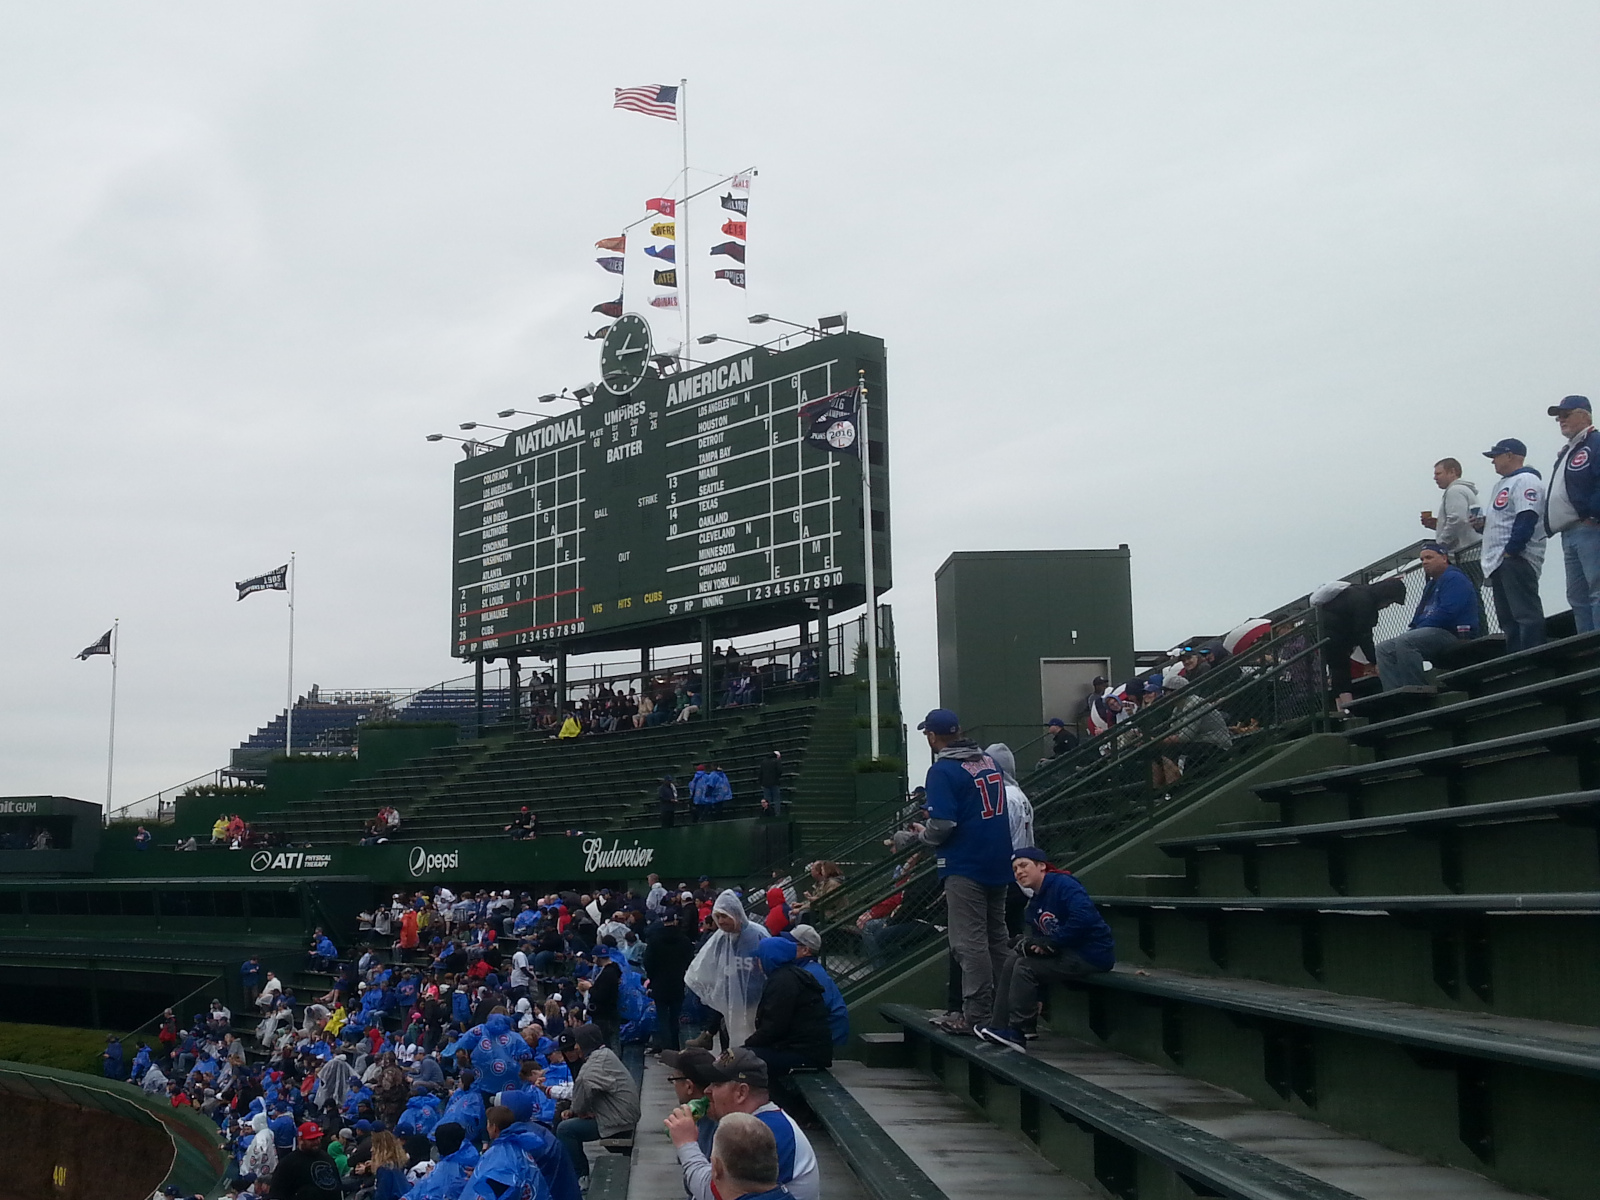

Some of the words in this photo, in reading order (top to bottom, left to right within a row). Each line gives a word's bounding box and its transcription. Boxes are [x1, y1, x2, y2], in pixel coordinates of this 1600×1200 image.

[666, 356, 753, 407] AMERICAN
[604, 401, 646, 426] UMPIRES
[698, 405, 707, 417] LOS
[708, 398, 729, 414] ANGELES
[698, 415, 727, 433] HOUSTON
[516, 415, 585, 457] NATIONAL
[590, 428, 603, 439] PLATE
[612, 431, 618, 442] 32
[631, 425, 637, 437] 37
[698, 432, 724, 449] DETROIT
[829, 430, 853, 439] 2016
[607, 440, 642, 463] BATTER
[698, 450, 718, 465] TAMPA
[720, 446, 732, 458] BAY
[483, 469, 508, 485] COLORADO
[698, 466, 718, 480] MIAMI
[669, 477, 677, 489] 13
[699, 480, 724, 496] SEATTLE
[483, 498, 504, 512] ARIZONA
[638, 494, 658, 508] STRIKE
[671, 492, 676, 504] 5
[698, 498, 718, 512] TEXAS
[483, 514, 492, 525] SAN
[493, 511, 508, 523] DIEGO
[594, 508, 608, 519] BALL
[669, 508, 678, 520] 14
[698, 512, 728, 528] OAKLAND
[482, 524, 508, 539] BALTIMORE
[669, 524, 677, 536] 10
[698, 527, 735, 544] CLEVELAND
[482, 538, 508, 553] CINCINNATI
[698, 543, 735, 560] MINNESOTA
[482, 551, 512, 566] WASHINGTON
[618, 551, 630, 562] OUT
[482, 568, 502, 580] ATLANTA
[698, 561, 727, 576] CHICAGO
[482, 579, 511, 594] PITTSBURGH
[699, 580, 713, 593] NEW
[713, 577, 729, 590] YORK
[461, 590, 466, 599] 2
[489, 595, 503, 606] LOUIS
[669, 604, 677, 614] SP
[685, 600, 693, 611] RP
[703, 595, 723, 608] INNING
[747, 590, 751, 601] 1
[755, 588, 761, 600] 2
[765, 586, 771, 598] 3
[774, 584, 781, 596] 4
[784, 582, 790, 594] 5
[794, 580, 800, 592] 6
[804, 578, 810, 591] 7
[814, 577, 820, 589] 8
[824, 575, 830, 587] 9
[833, 572, 842, 585] 10
[460, 603, 466, 613] 13
[592, 604, 603, 614] VIS
[618, 598, 631, 609] HITS
[644, 591, 663, 603] CUBS
[459, 617, 466, 627] 33
[481, 608, 508, 622] MILWAUKEE
[459, 645, 466, 654] SP
[483, 639, 498, 649] INNING
[516, 634, 519, 644] 1
[522, 633, 527, 643] 2
[529, 631, 534, 642] 3
[535, 630, 540, 640] 4
[542, 629, 547, 639] 5
[549, 627, 554, 638] 6
[557, 626, 562, 637] 7
[563, 625, 568, 635] 8
[571, 623, 576, 634] 9
[577, 622, 584, 633] 10
[481, 625, 494, 636] CUBS
[974, 773, 1004, 819] 17
[15, 802, 37, 813] GUM
[271, 853, 304, 869] ATI
[427, 850, 458, 873] pepsi
[582, 837, 654, 873] Budweiser
